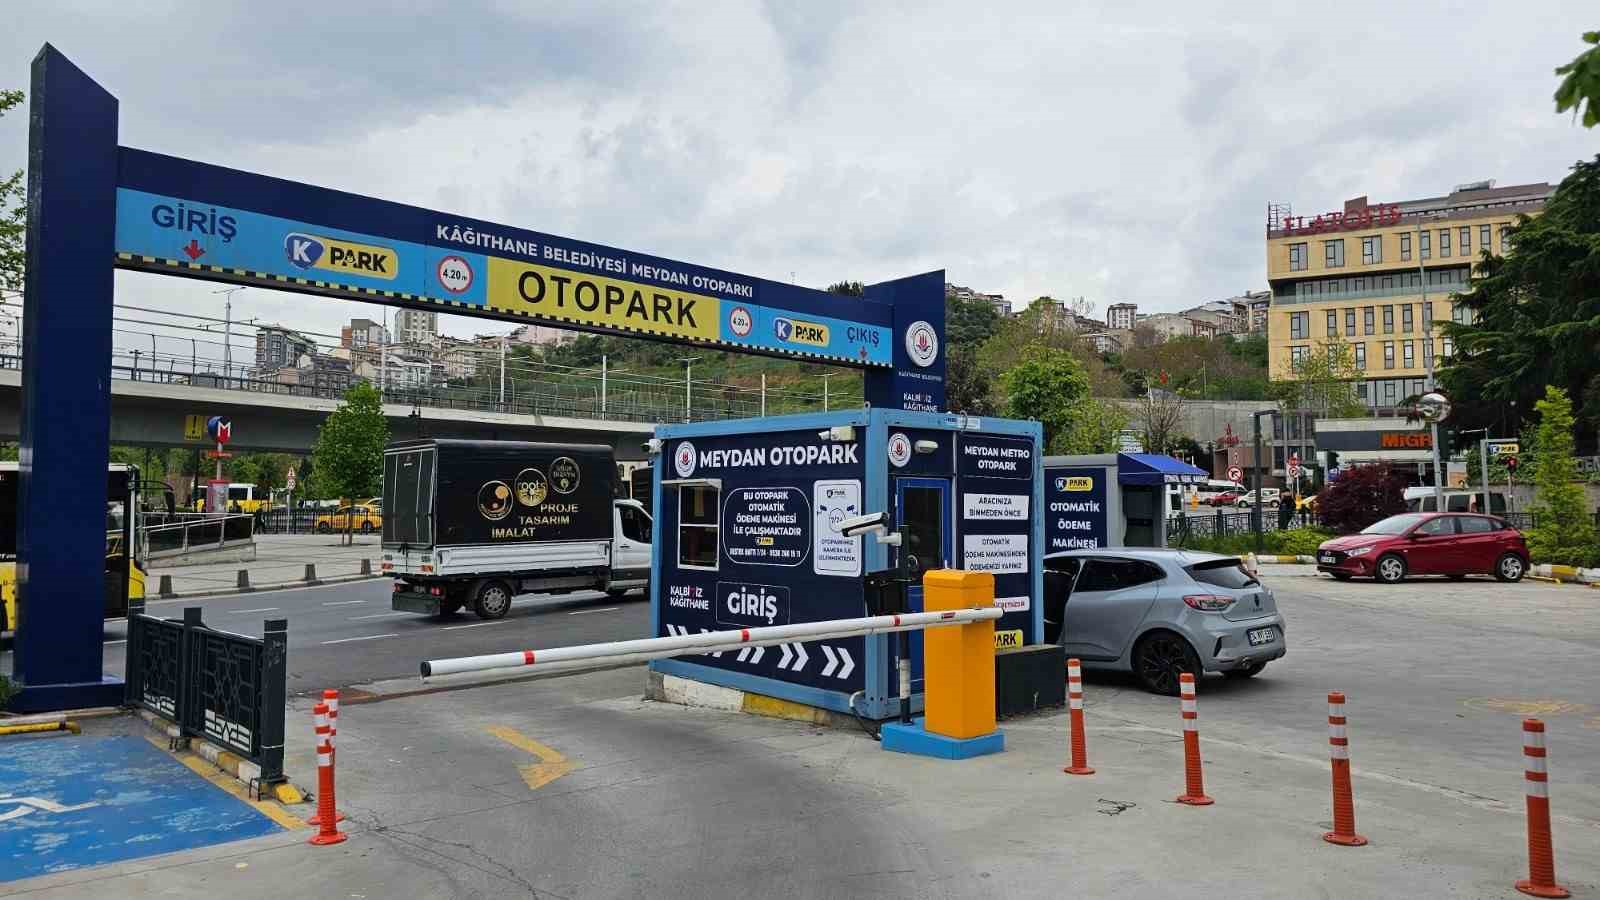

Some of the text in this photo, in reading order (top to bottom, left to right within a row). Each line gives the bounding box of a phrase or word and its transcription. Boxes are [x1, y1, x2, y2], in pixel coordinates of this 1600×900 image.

[151, 202, 237, 244] GİRİŞ
[292, 238, 387, 273] K PARK
[437, 224, 753, 298] KÂĞITHANE BELEDİYESİ MEYDAN OTOPARKI
[443, 267, 461, 281] 4.20
[518, 270, 698, 329] OTOPARK
[777, 322, 824, 343] K PARK
[847, 327, 880, 348] ÇIKIŞ
[700, 443, 858, 468] MEYDAN OTOPARK
[965, 446, 1030, 459] MEYDAN METRO
[978, 460, 1017, 471] OTOPARK
[1069, 479, 1088, 487] PARK
[743, 491, 789, 500] BU OTOPARK
[540, 503, 579, 513] PROJE
[748, 501, 785, 511] OTOMATİK
[1050, 500, 1100, 513] OTOMATİK
[519, 515, 569, 526] TASARIM
[736, 512, 797, 524] ÖDEME MAKİNESİ
[1058, 519, 1091, 530] ÖDEME
[733, 524, 802, 537] İLE ÇALIŞMAKTADIR
[1053, 536, 1098, 549] MAKİNESİ
[670, 595, 710, 610] KÂĞITHANE
[727, 586, 778, 624] GİRİŞ
[994, 633, 1017, 647] ARK
